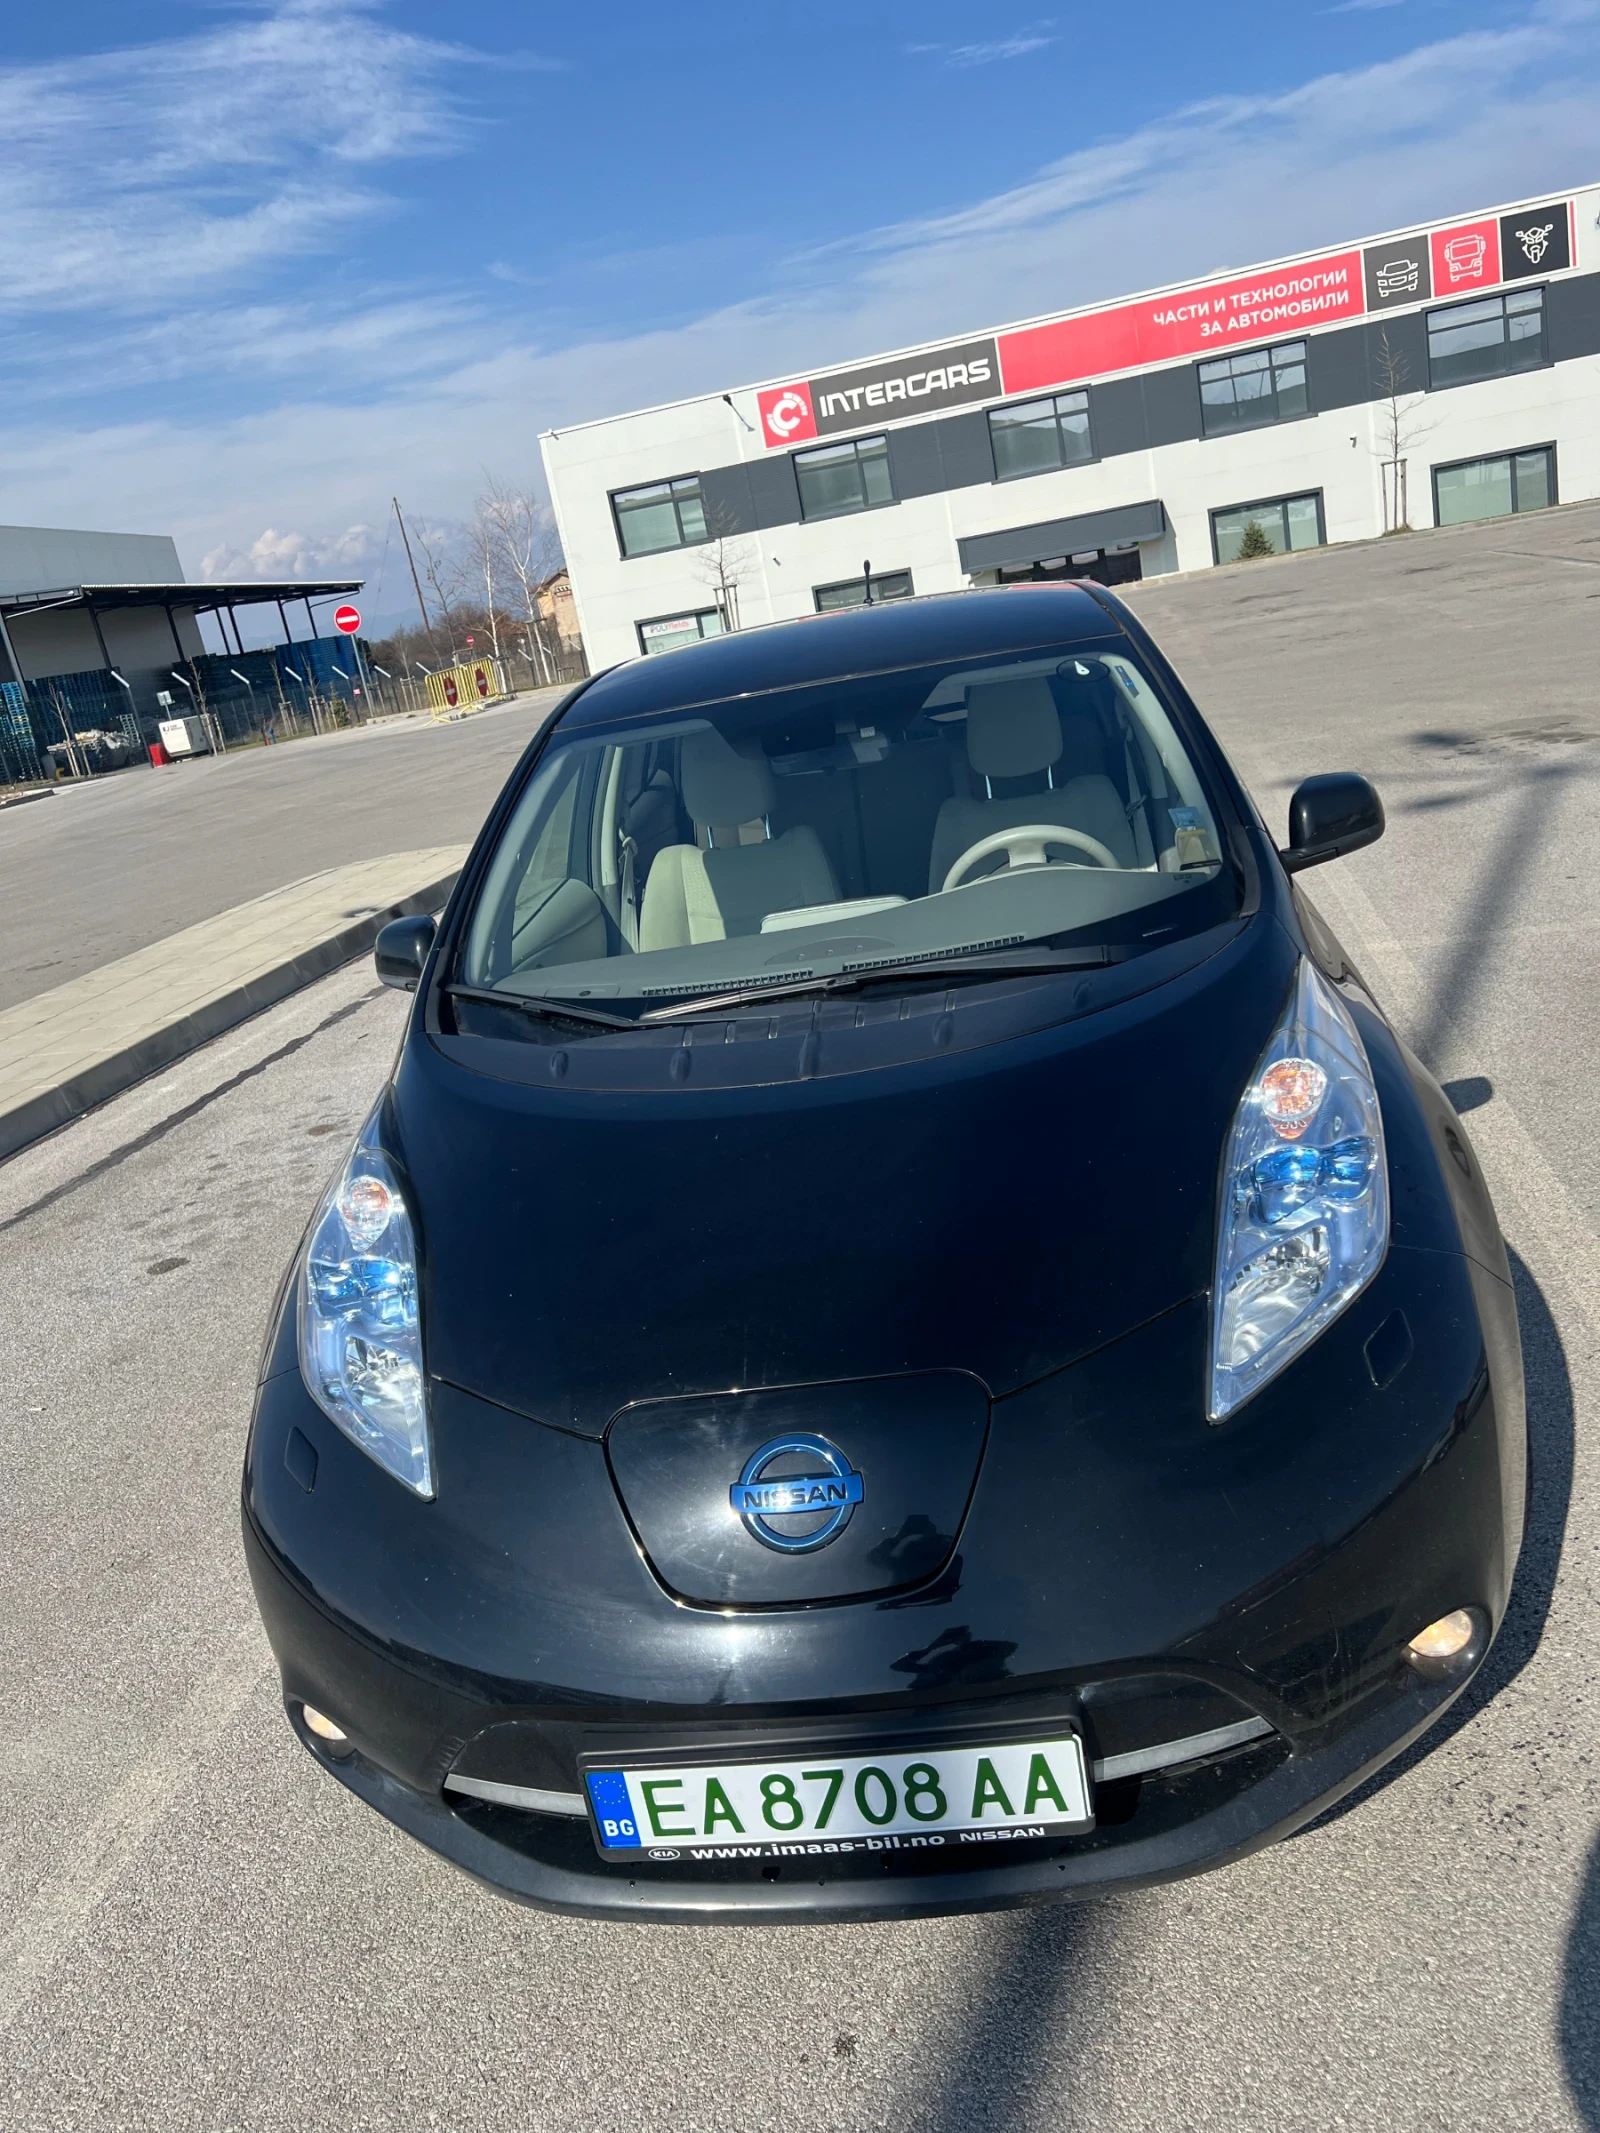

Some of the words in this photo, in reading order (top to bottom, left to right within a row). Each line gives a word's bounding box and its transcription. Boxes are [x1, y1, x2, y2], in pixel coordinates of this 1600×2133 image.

[1153, 302, 1210, 326] ЧАСТИ
[1214, 298, 1226, 313] И
[1230, 268, 1348, 309] ТЕХНОЛОГИИ
[1200, 321, 1223, 337] ЗА
[1227, 290, 1349, 331] АВТОМОБИЛИ
[819, 358, 991, 418] INTERCARS
[744, 1482, 848, 1508] NISSAN
[640, 1777, 747, 1837] EA
[759, 1762, 948, 1831] 8708
[971, 1753, 1070, 1819] AA
[603, 1819, 635, 1837] BG
[690, 1835, 946, 1859] www.imaas-bil.no
[959, 1827, 1045, 1842] NISSAN
